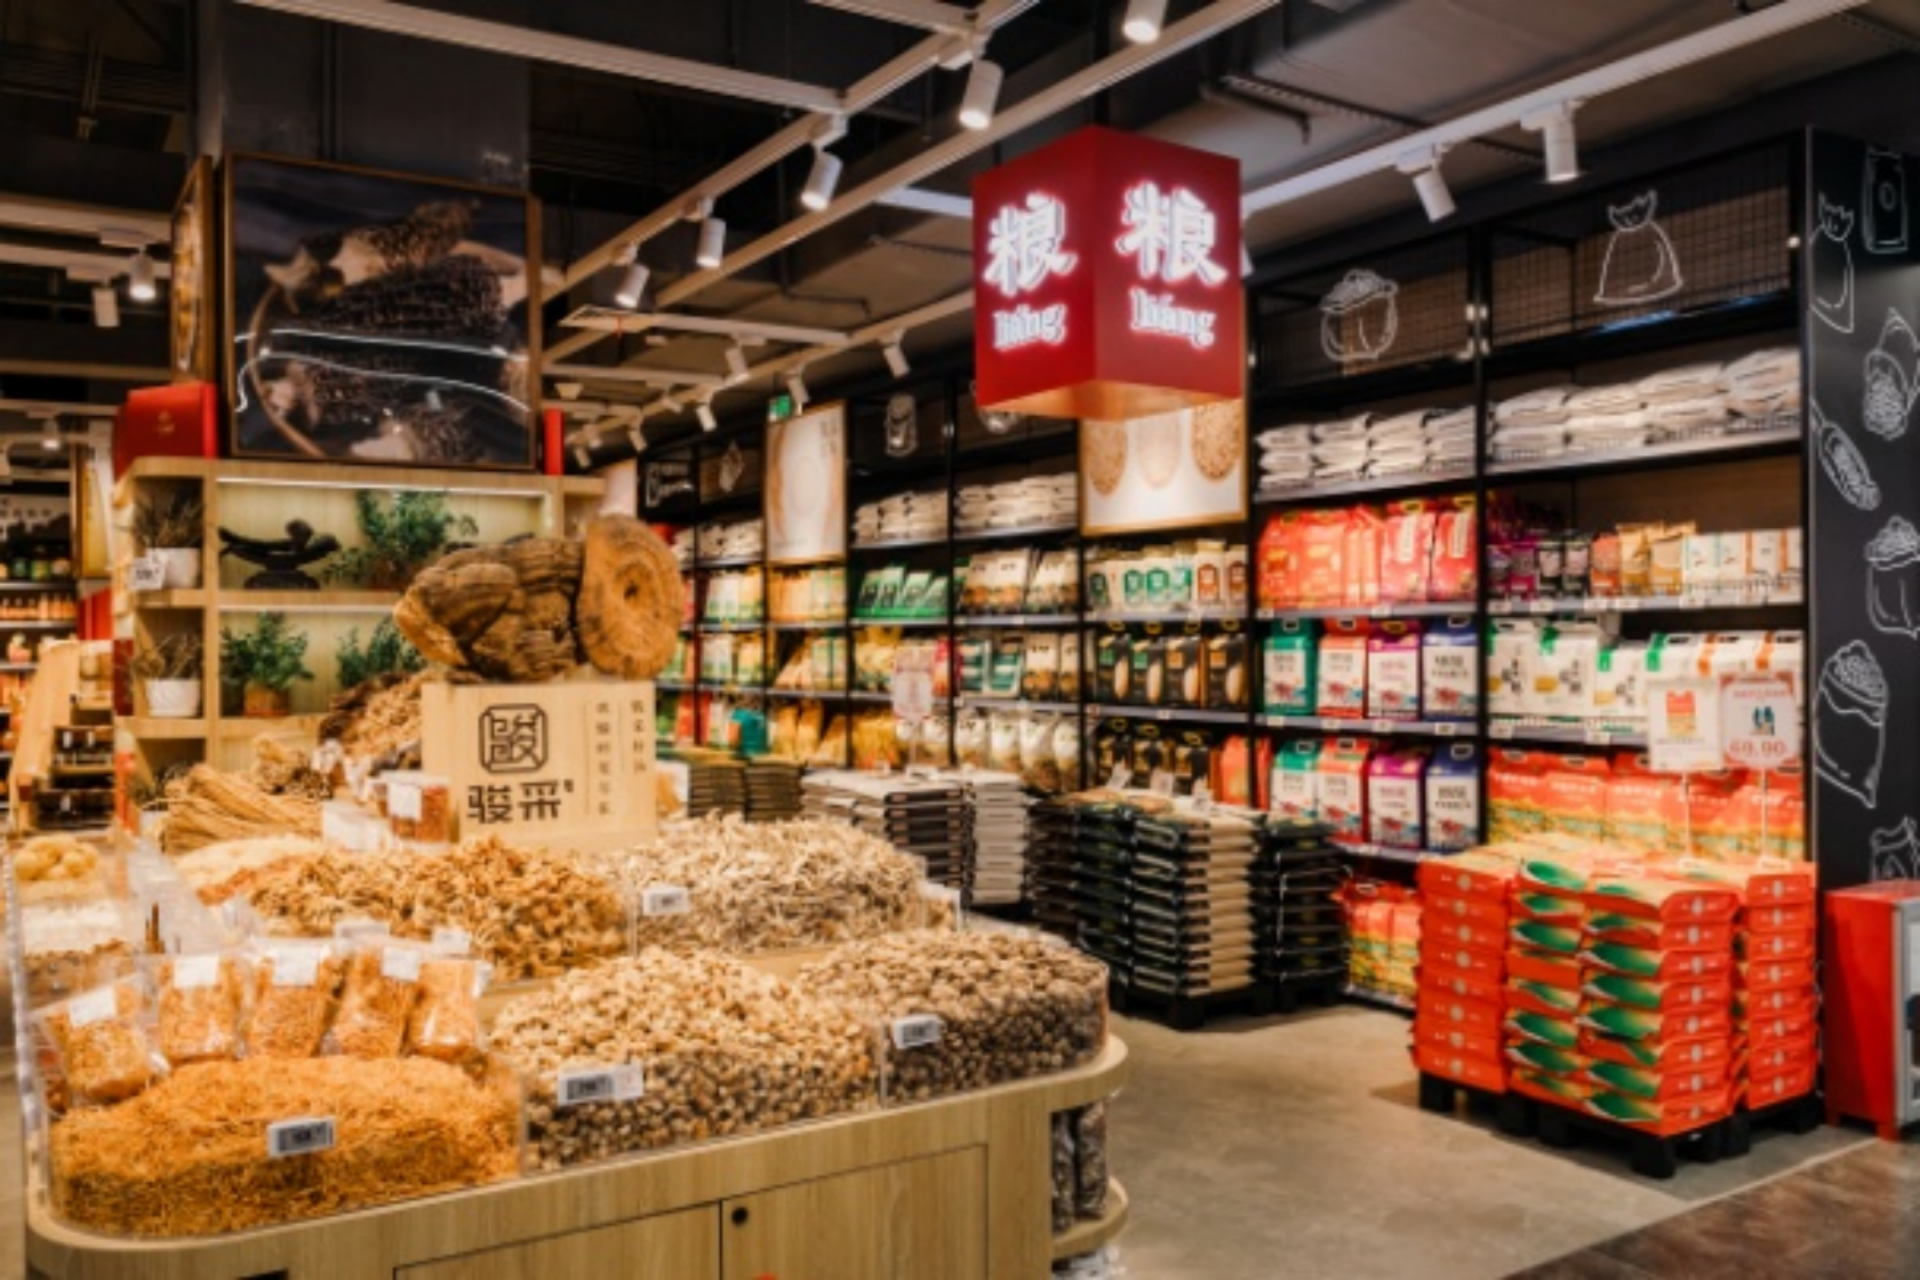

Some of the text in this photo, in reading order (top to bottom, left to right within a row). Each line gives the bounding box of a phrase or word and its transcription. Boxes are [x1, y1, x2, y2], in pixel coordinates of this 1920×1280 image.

[984, 192, 1077, 295] 粮
[1115, 183, 1227, 285] 粮
[467, 780, 561, 824] 骏采
